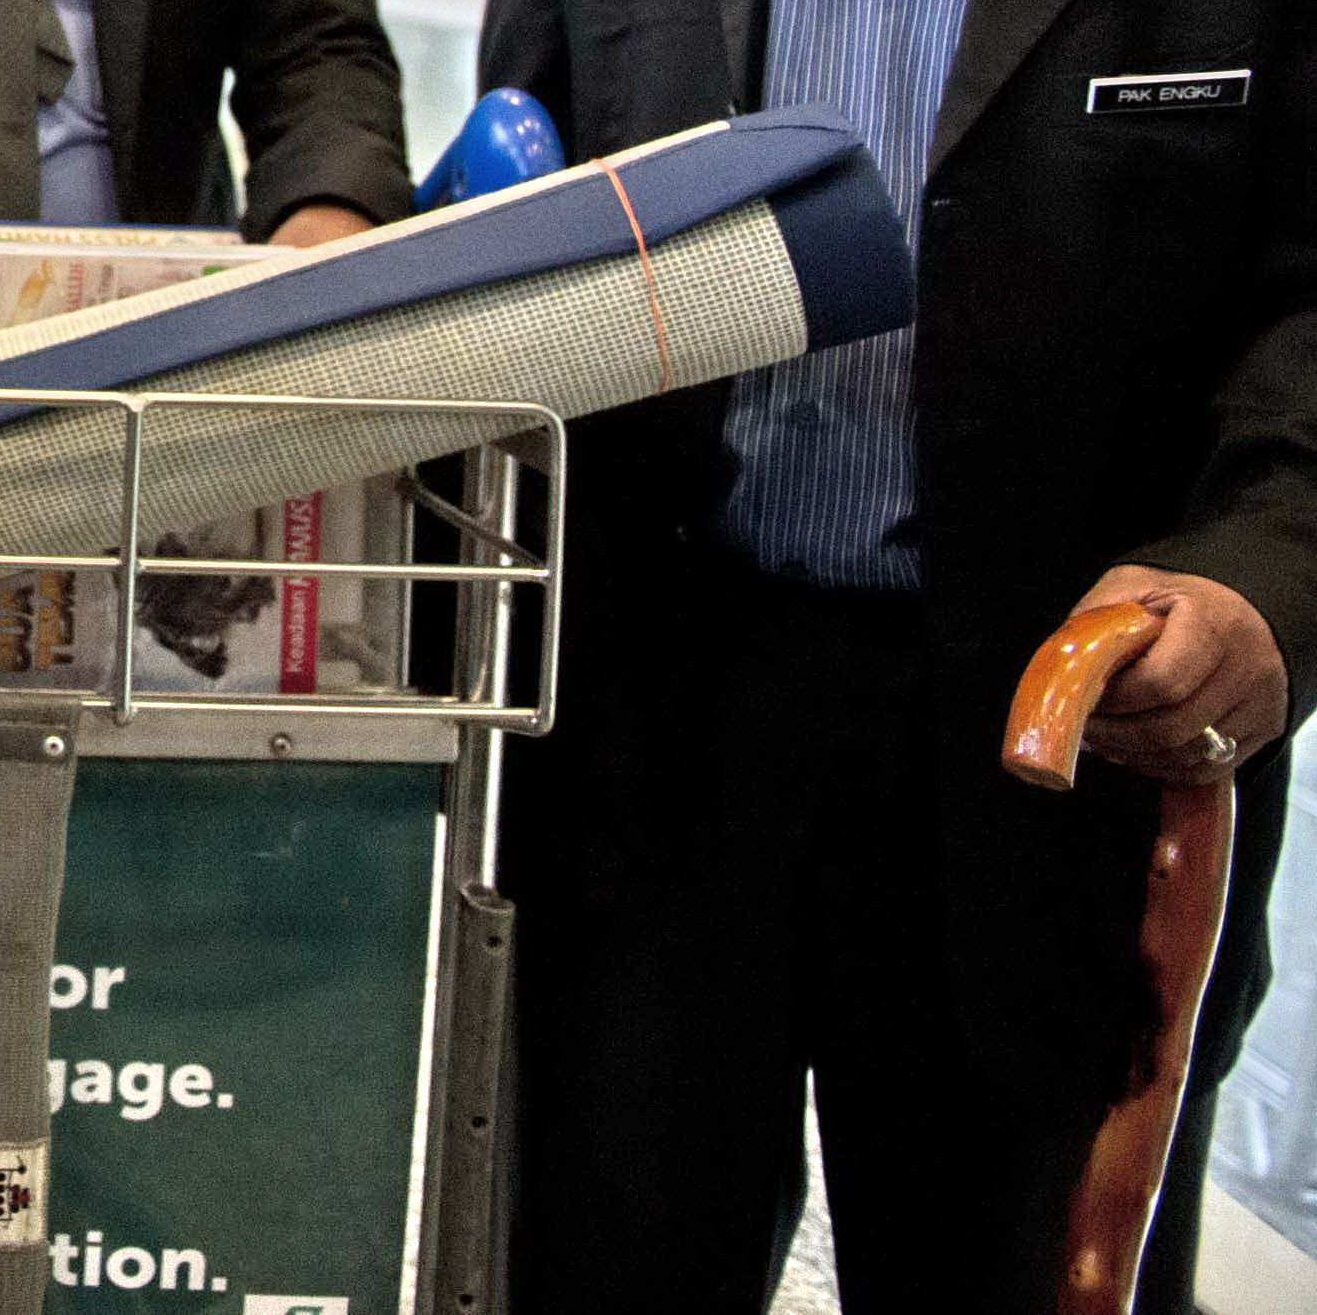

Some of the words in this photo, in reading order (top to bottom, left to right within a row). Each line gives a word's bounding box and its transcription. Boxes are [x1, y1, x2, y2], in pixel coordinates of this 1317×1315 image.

[1118, 87, 1151, 102] PAK
[1159, 85, 1222, 101] ENGKU
[49, 964, 126, 1010] or
